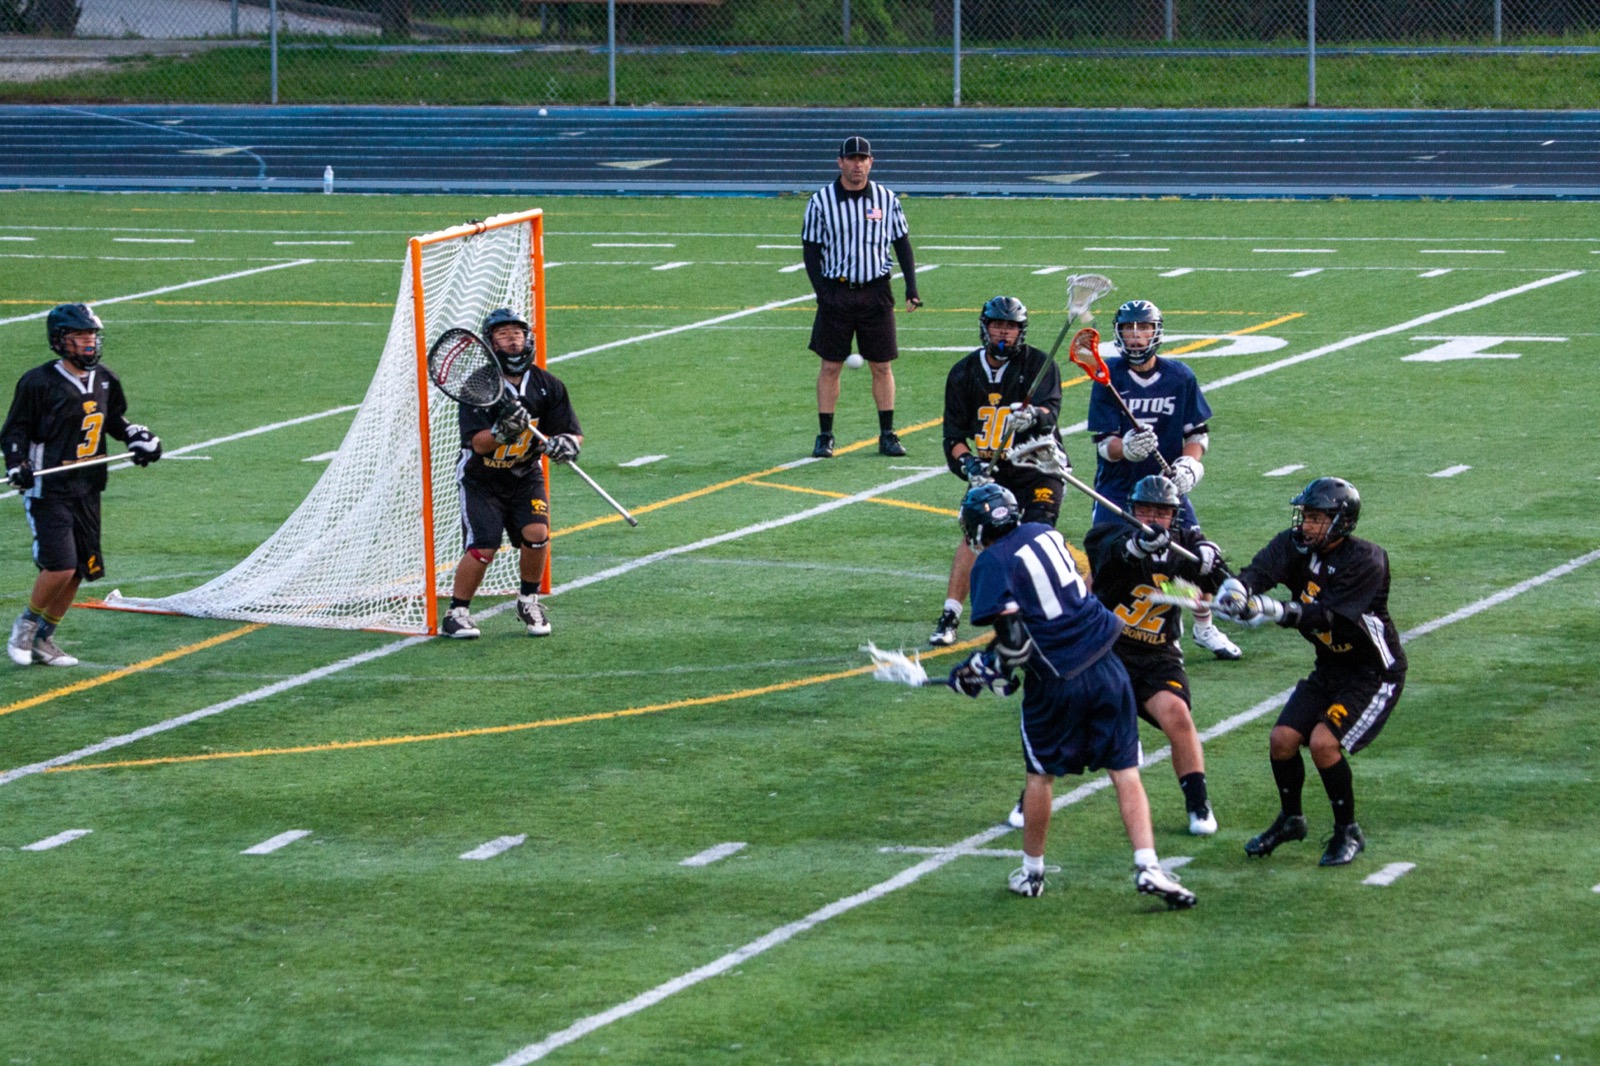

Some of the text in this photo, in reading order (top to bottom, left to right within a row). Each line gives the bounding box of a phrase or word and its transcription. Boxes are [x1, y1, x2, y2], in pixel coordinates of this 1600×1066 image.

[76, 412, 104, 459] 3
[975, 406, 1015, 450] 30
[1014, 530, 1087, 620] 14
[1113, 584, 1172, 634] 32
